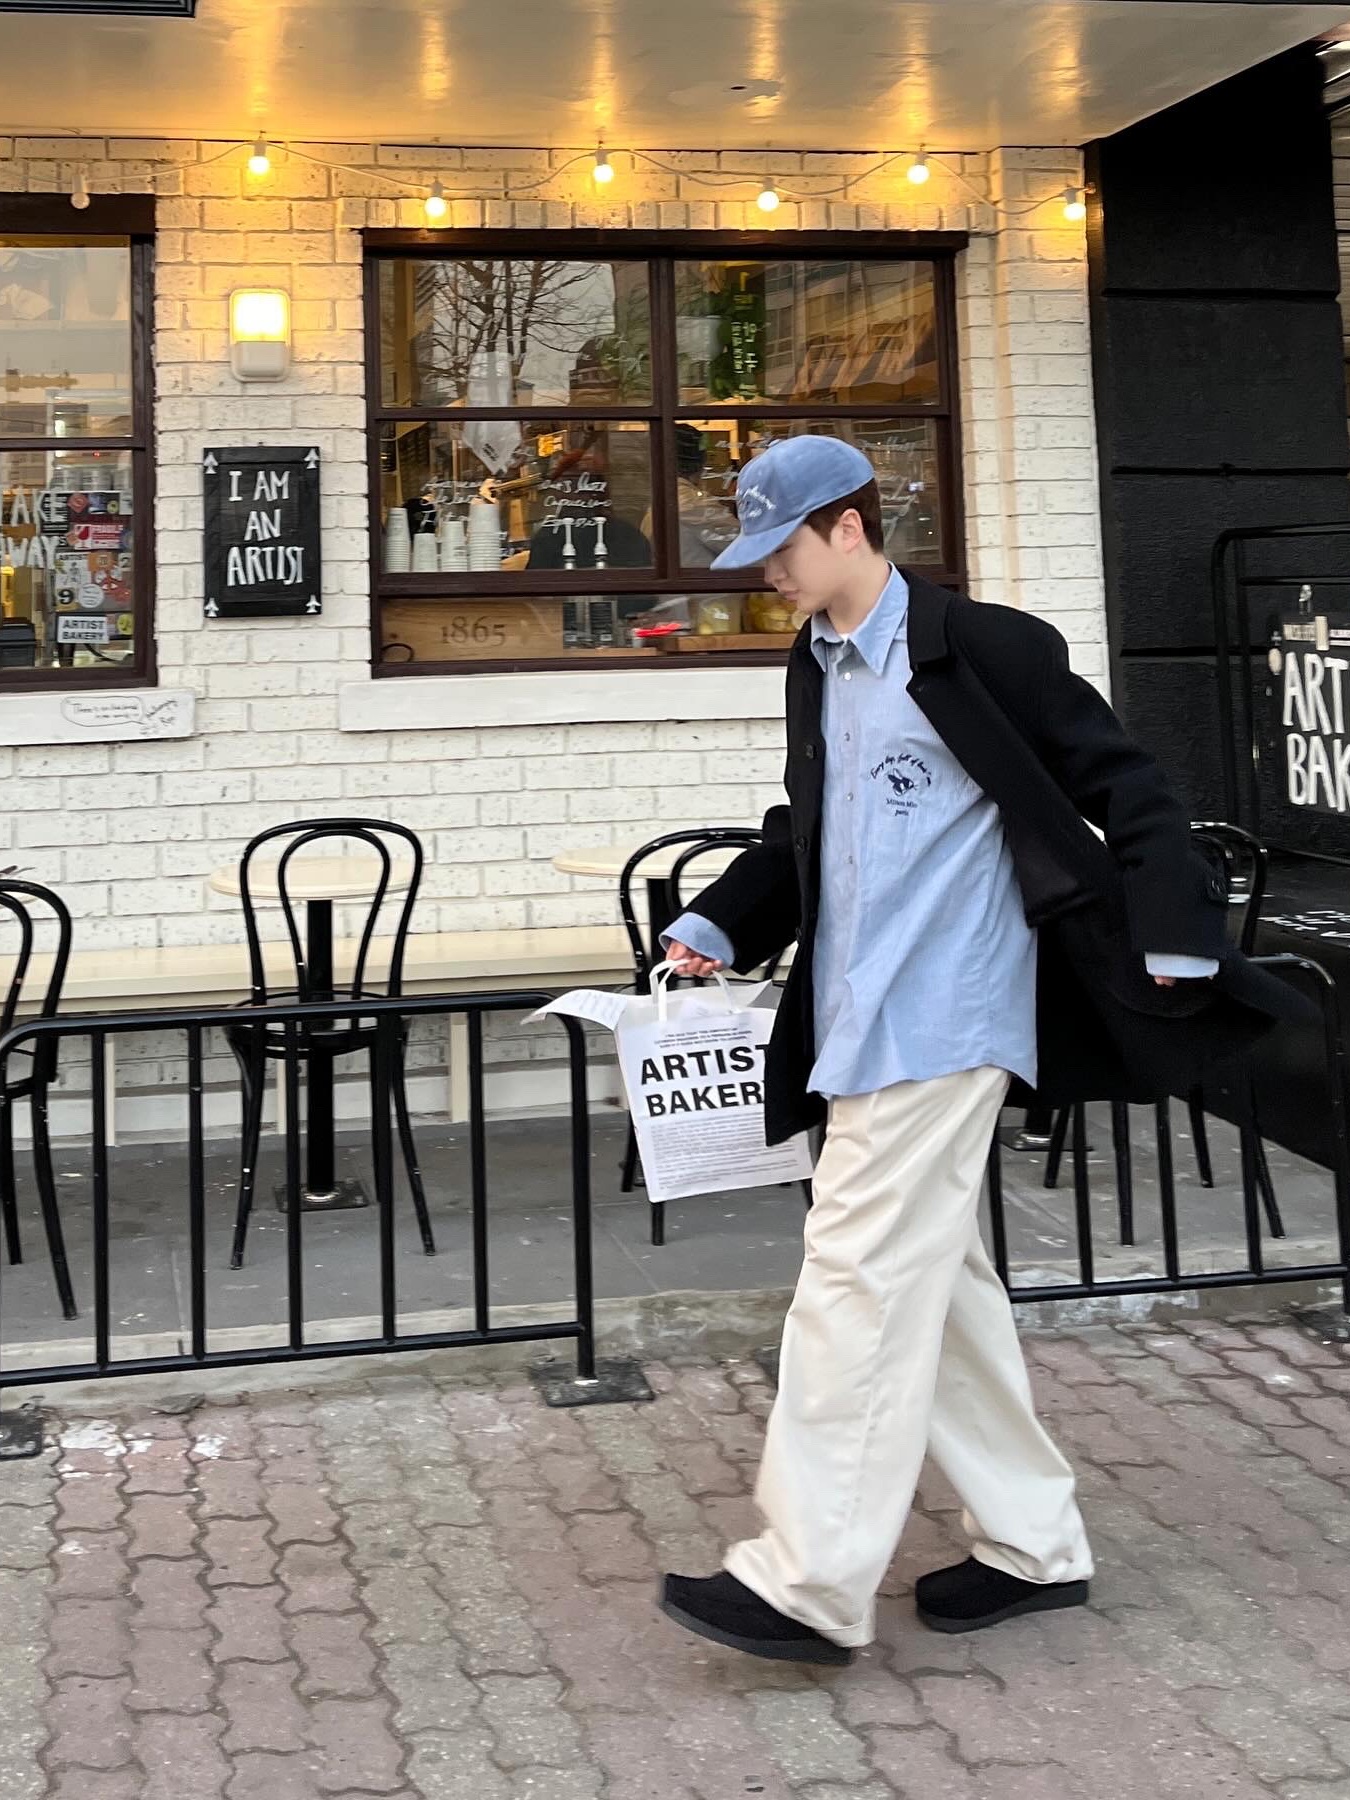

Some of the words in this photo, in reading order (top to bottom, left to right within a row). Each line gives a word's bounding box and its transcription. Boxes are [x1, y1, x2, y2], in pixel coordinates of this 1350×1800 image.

[228, 470, 243, 501] I
[253, 470, 290, 501] AM
[0, 486, 68, 532] AKE
[244, 508, 281, 541] AN
[227, 546, 304, 586] ARTIST
[58, 588, 74, 605] 9
[62, 619, 105, 630] ARTIST
[62, 631, 105, 640] BAKERY
[440, 615, 507, 647] 1865
[1282, 651, 1349, 735] ART
[1287, 732, 1350, 813] BAK
[646, 1081, 765, 1117] BAKER
